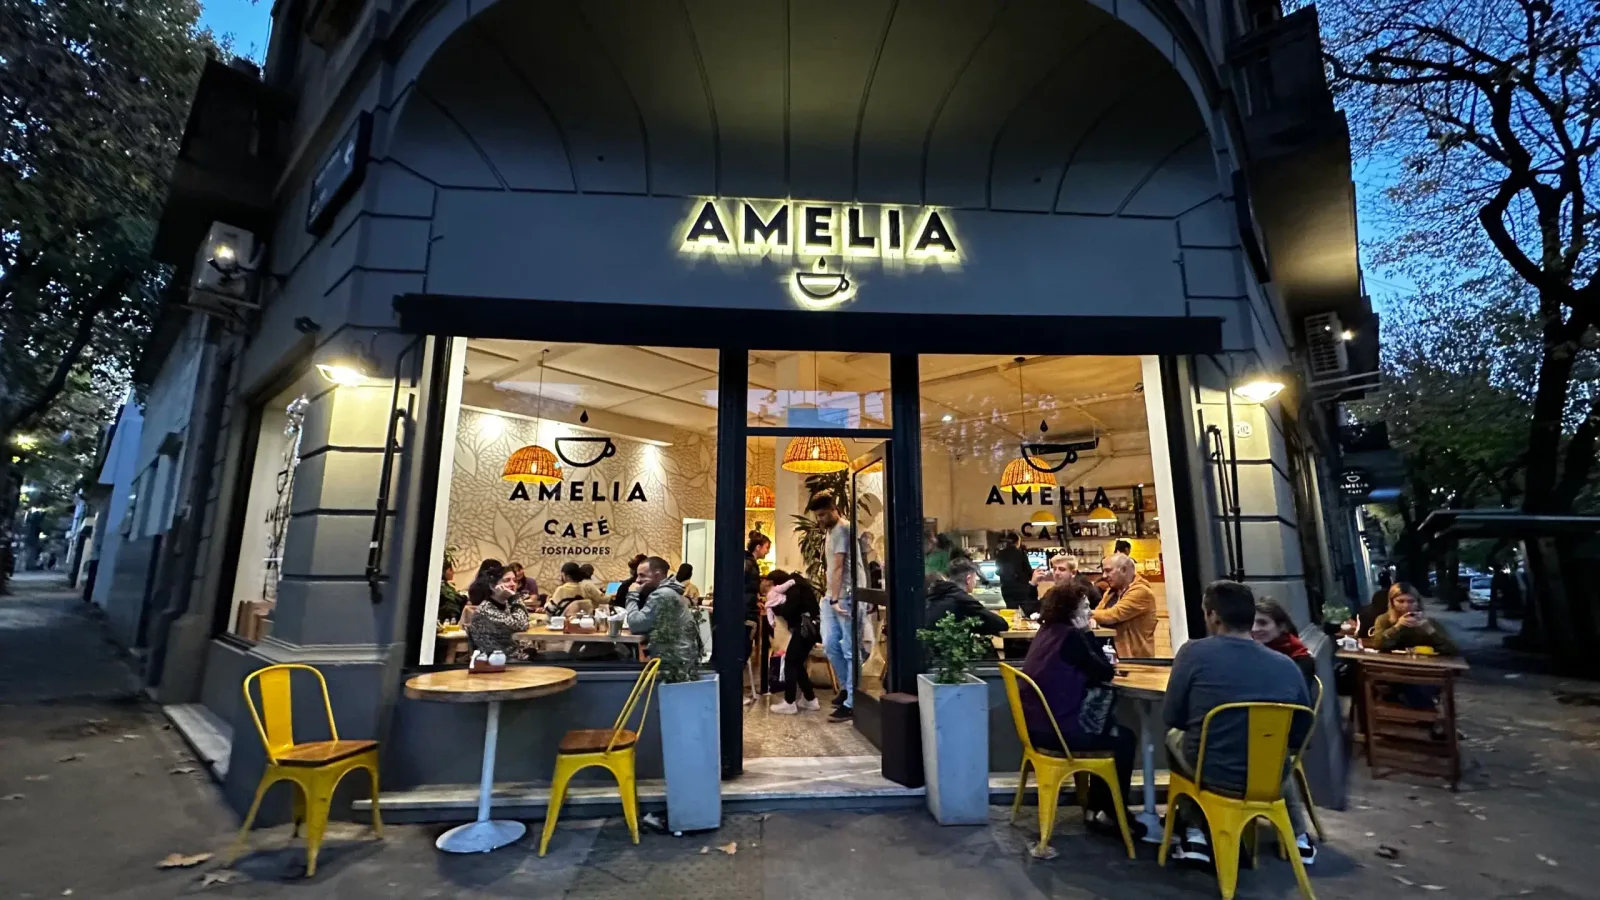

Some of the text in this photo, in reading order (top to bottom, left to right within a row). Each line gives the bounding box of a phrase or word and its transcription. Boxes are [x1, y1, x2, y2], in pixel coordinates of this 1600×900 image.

[686, 201, 957, 252] AMELIA
[509, 481, 647, 501] AMELIA
[986, 485, 1111, 505] AMELIA
[544, 516, 610, 538] CAFÉ
[541, 546, 610, 555] TOSTADORES
